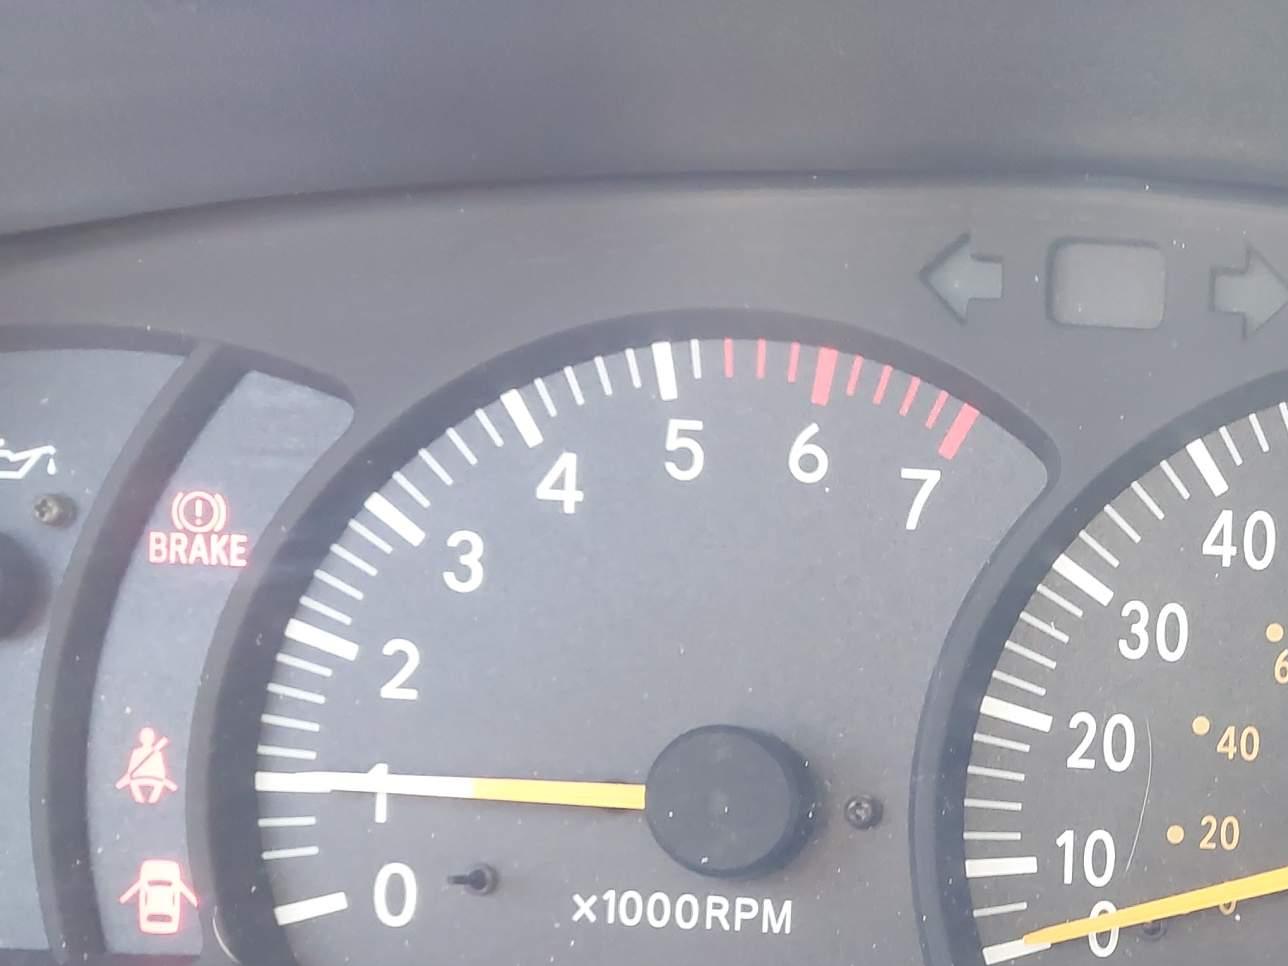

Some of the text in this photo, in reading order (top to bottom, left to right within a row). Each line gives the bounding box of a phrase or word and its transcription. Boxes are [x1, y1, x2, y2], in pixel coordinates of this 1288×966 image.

[664, 418, 705, 481] 5
[788, 422, 829, 484] 6
[535, 451, 585, 515] 4
[900, 467, 941, 530] 7
[149, 532, 248, 567] BRAKE
[442, 530, 484, 593] 3
[1202, 509, 1276, 571] 40
[1118, 600, 1189, 662] 30
[380, 638, 420, 700] 2
[1066, 711, 1135, 772] 20
[1216, 725, 1260, 761] 40
[367, 762, 389, 824] 1
[1055, 829, 1116, 887] 10
[1199, 815, 1240, 851] 20
[373, 862, 418, 927] 0
[1088, 900, 1120, 958] 0
